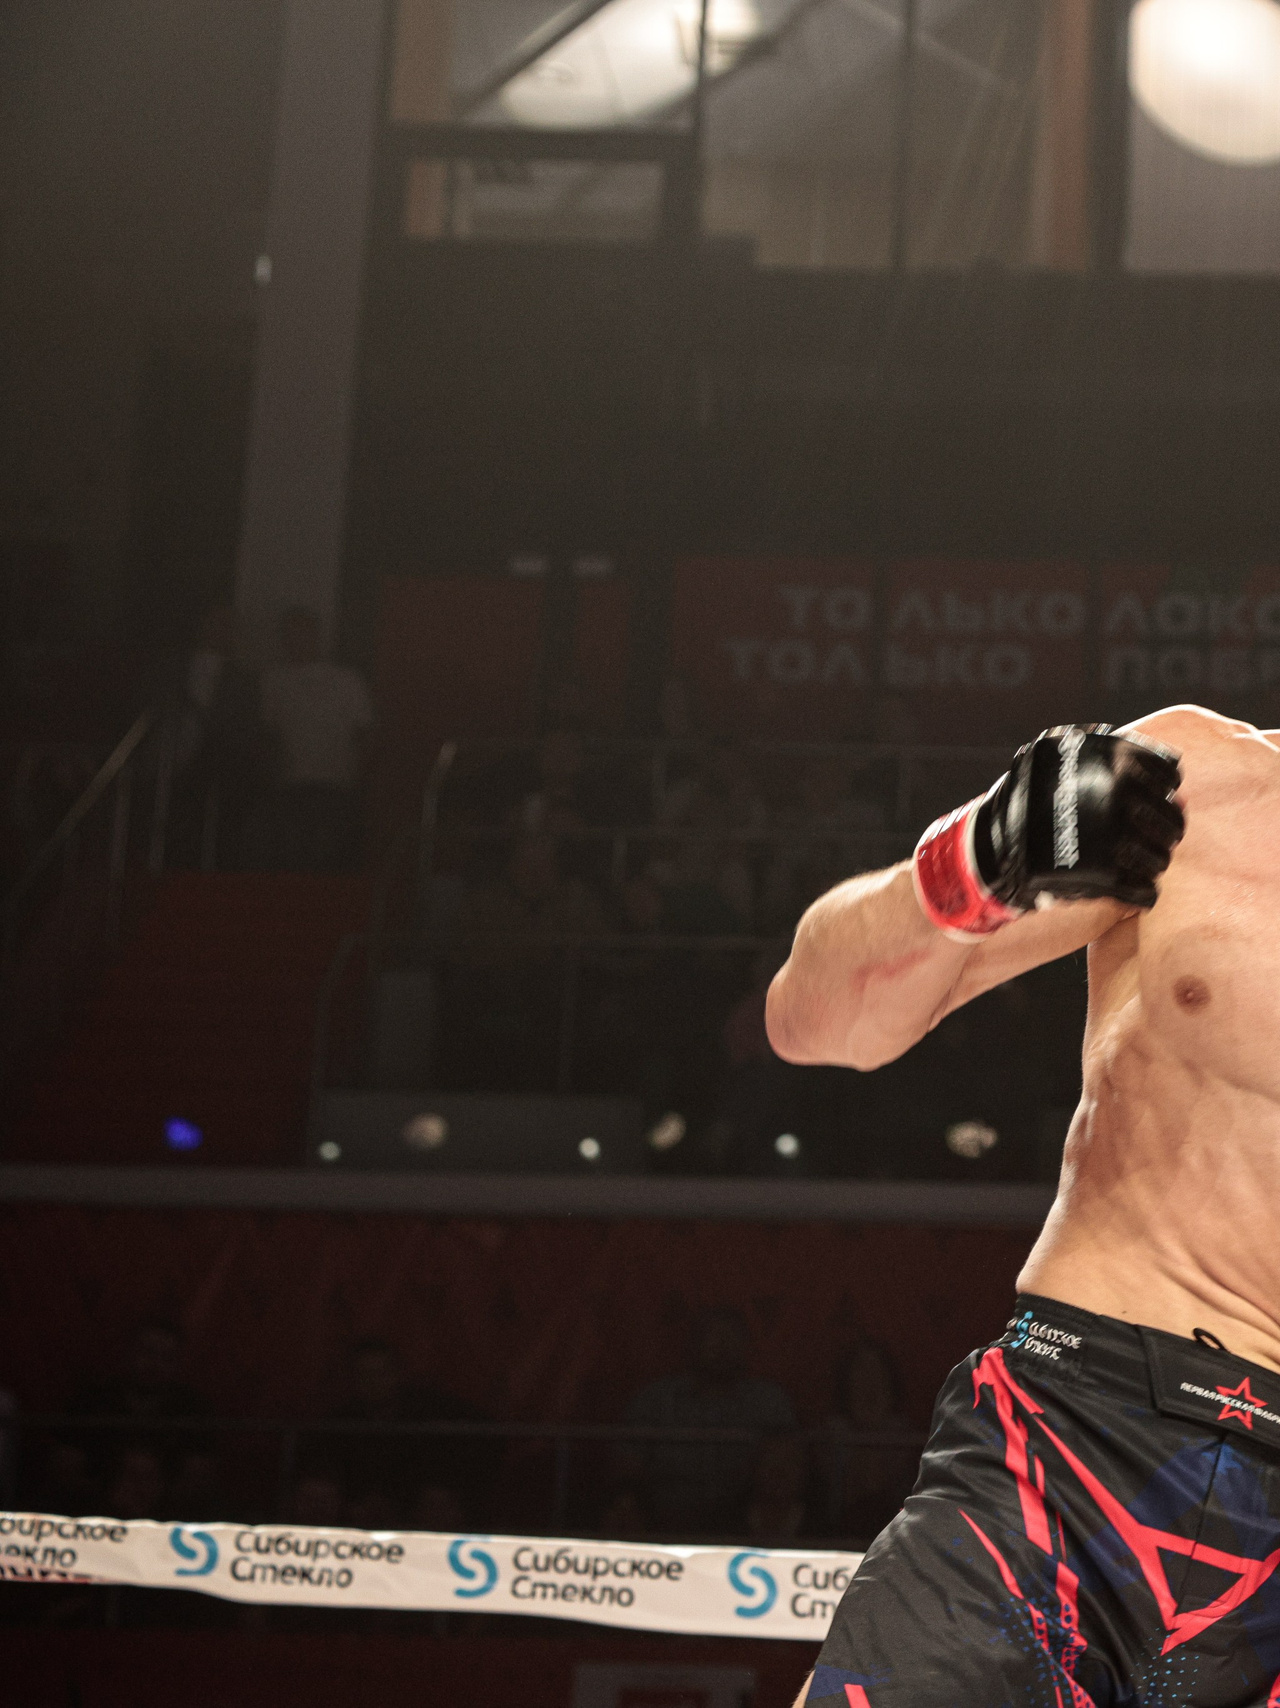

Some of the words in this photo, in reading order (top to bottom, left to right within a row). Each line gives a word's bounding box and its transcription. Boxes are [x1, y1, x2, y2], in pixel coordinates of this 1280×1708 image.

[234, 1531, 405, 1563] Сибирское
[230, 1556, 354, 1589] Стекло
[512, 1546, 685, 1582] Сибирское
[511, 1575, 635, 1608] Стекло
